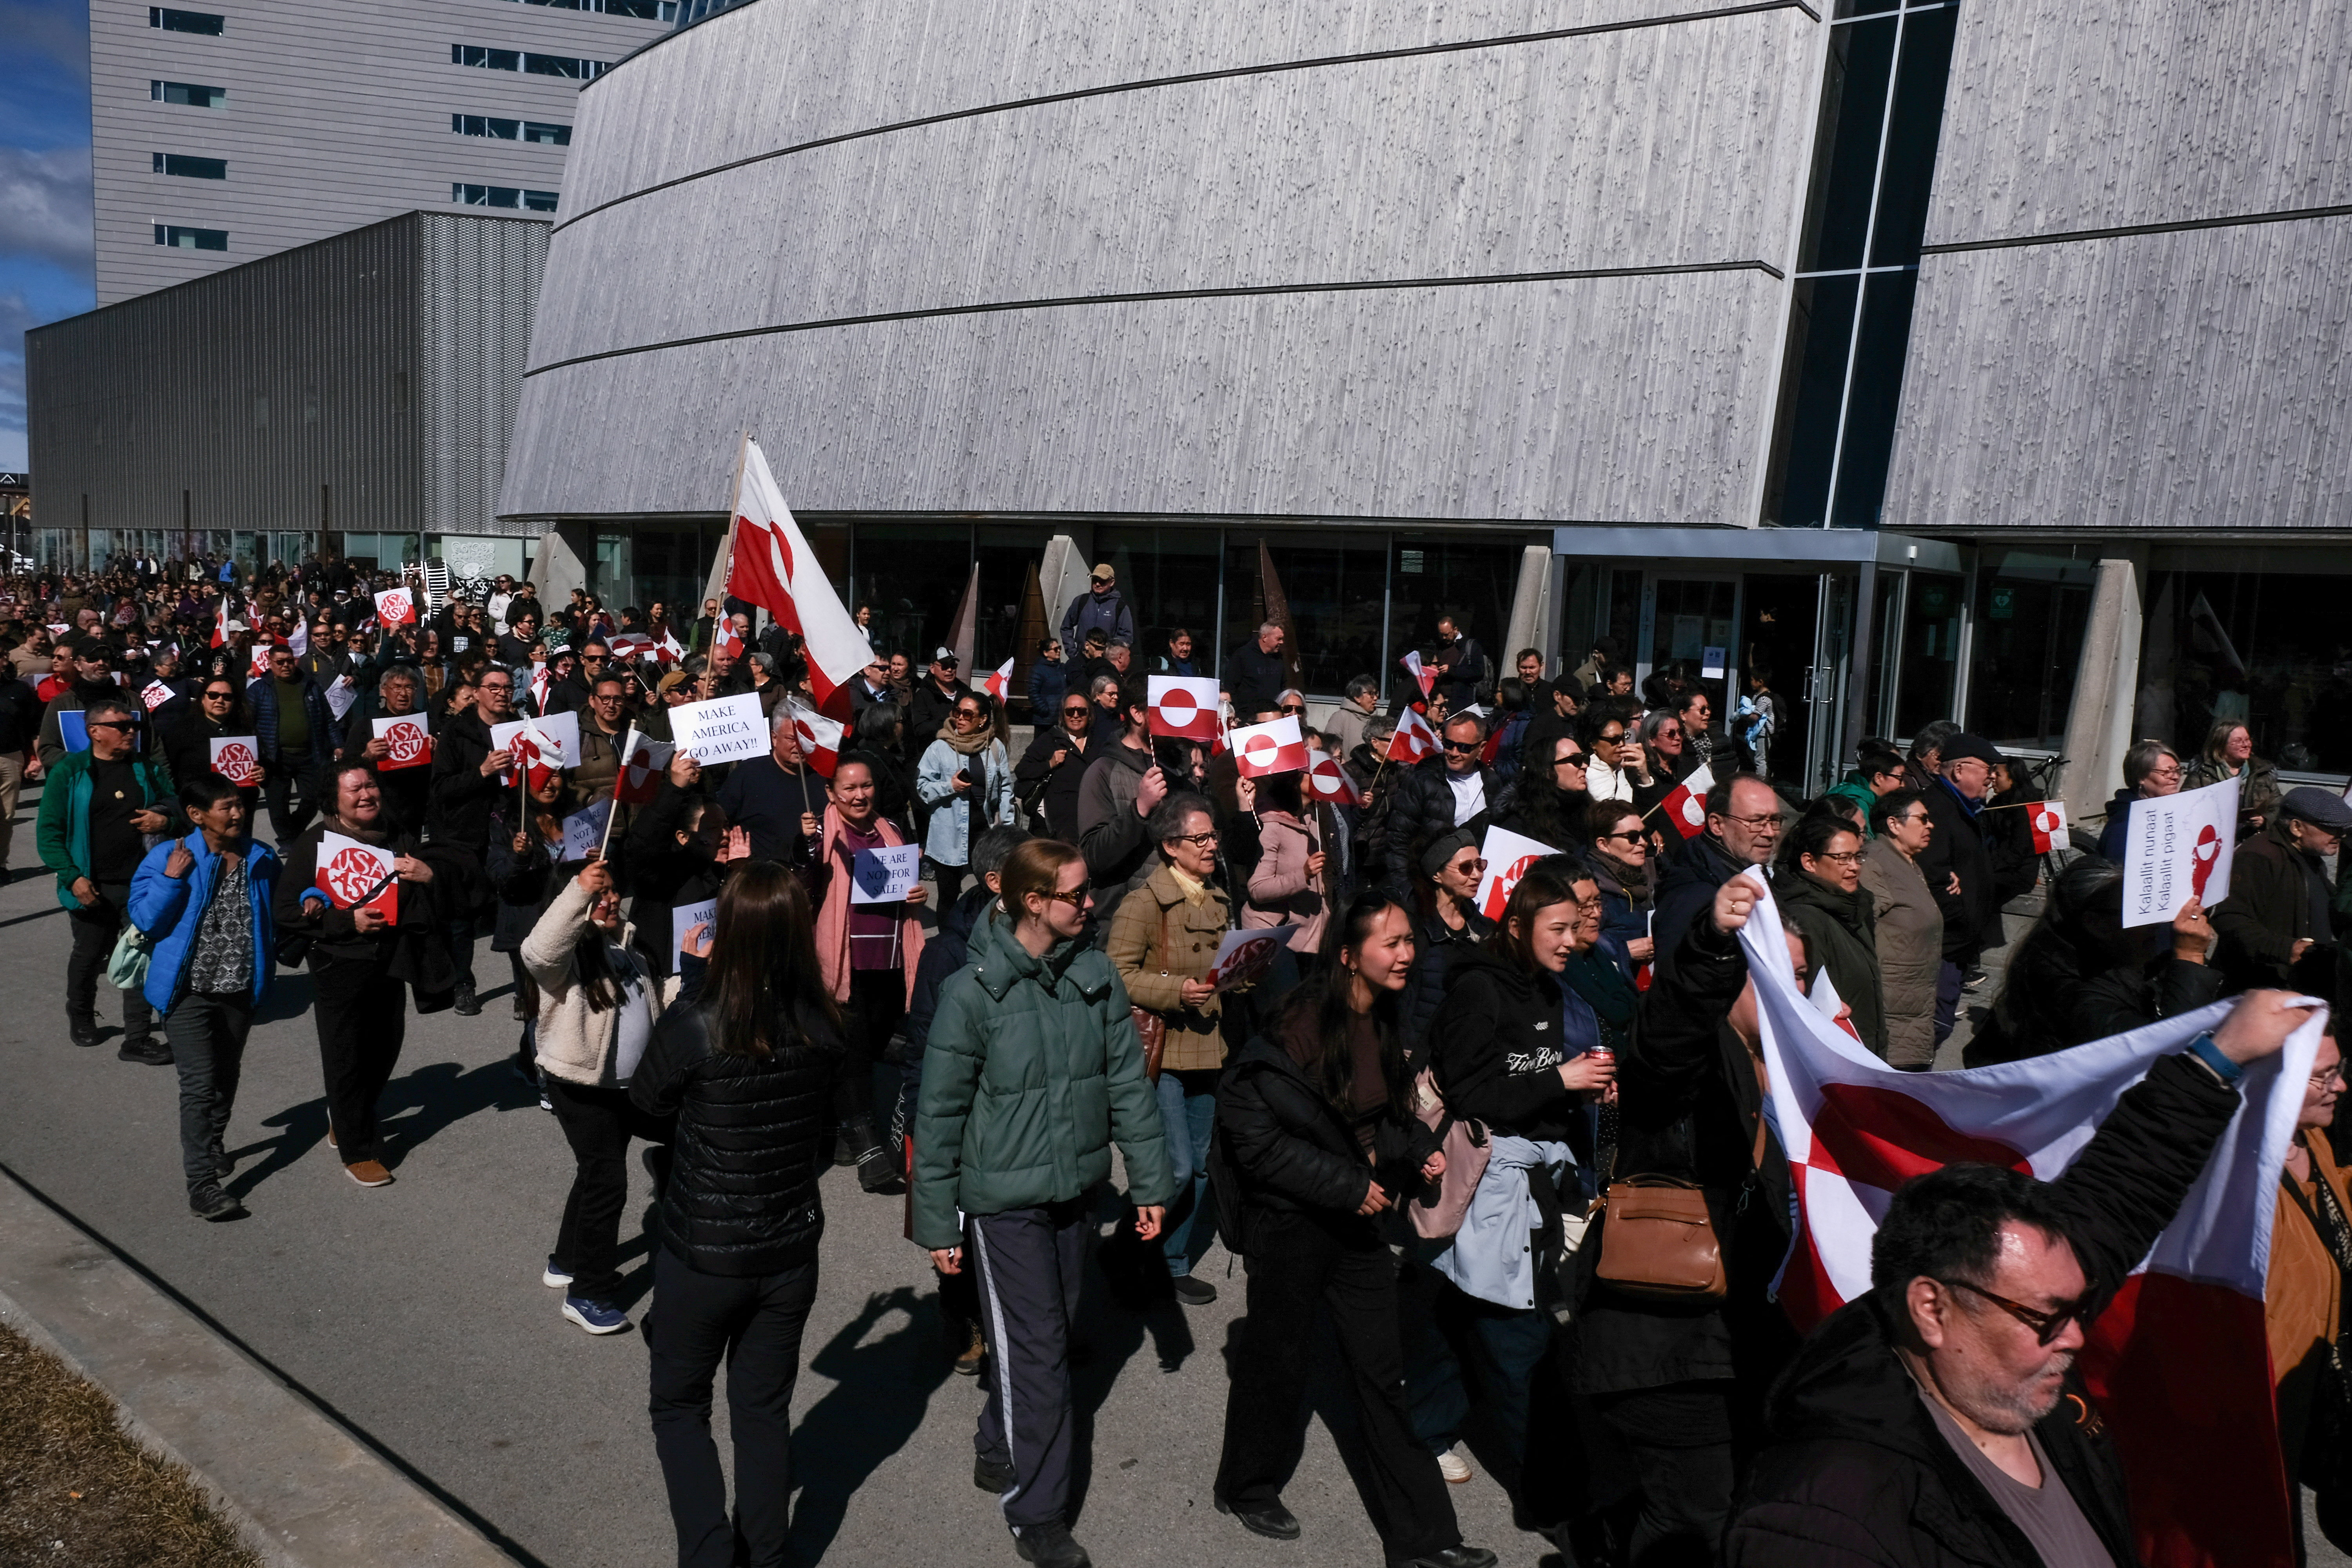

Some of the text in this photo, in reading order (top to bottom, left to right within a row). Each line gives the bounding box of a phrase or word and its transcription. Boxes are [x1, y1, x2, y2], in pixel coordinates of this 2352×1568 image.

[382, 595, 406, 610] USA
[698, 705, 736, 721] MAKE
[385, 724, 421, 746] USA
[691, 721, 750, 740] AMERICA
[220, 744, 252, 763] USA
[690, 738, 758, 759] GO AWAY!!
[574, 809, 601, 827] WE ARE
[573, 828, 590, 842] NOT
[338, 849, 386, 880] USA
[872, 853, 907, 865] WE ARE
[2138, 809, 2157, 915] Kalaallit nunaat
[2157, 811, 2176, 911] Kalaallit pigaat
[867, 868, 910, 880] NOT FOR
[873, 884, 898, 895] SALE
